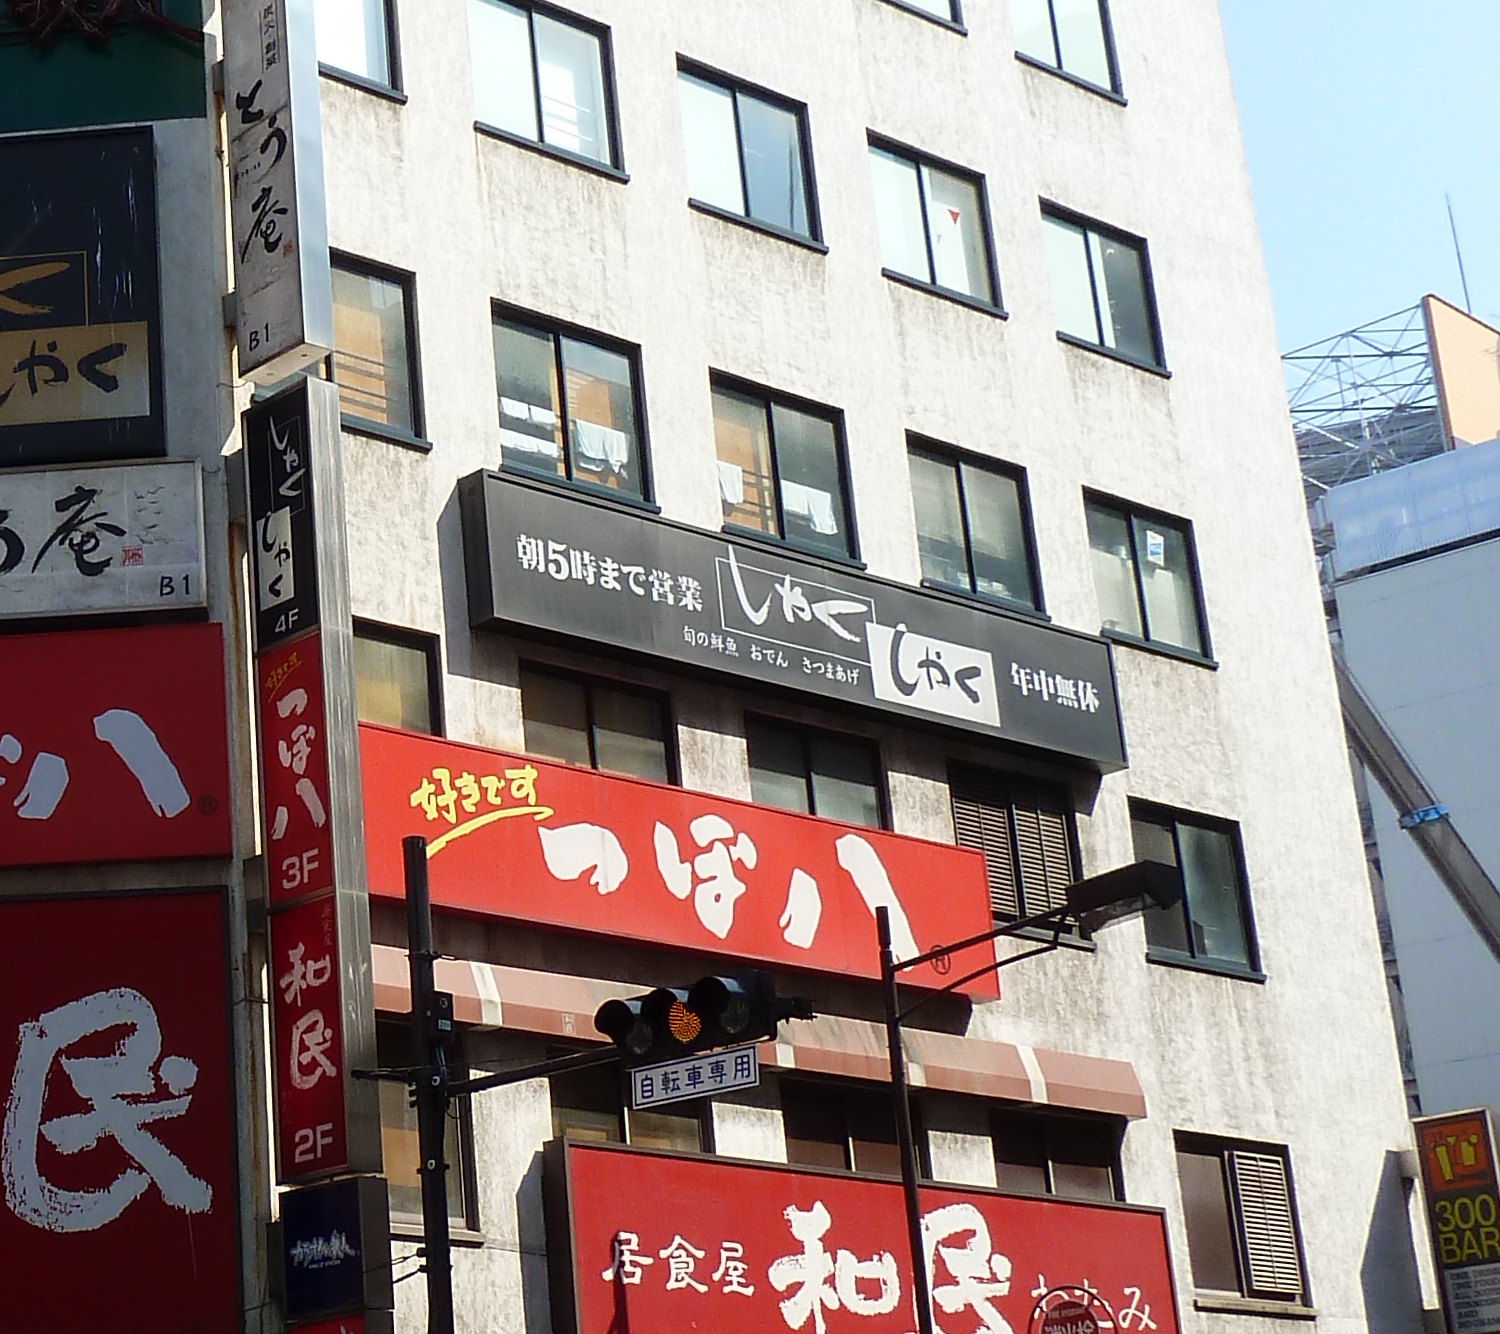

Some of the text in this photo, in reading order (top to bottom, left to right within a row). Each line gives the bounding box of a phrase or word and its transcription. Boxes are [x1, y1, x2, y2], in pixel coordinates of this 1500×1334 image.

[235, 79, 288, 265] とう庵
[248, 322, 270, 353] B1
[270, 416, 305, 497] しゃく
[262, 510, 291, 598] しゃく
[516, 533, 703, 613] 朝5時まで営業
[158, 573, 192, 597] B1
[275, 608, 300, 635] 4F
[728, 544, 982, 706] しゃく しゃく
[683, 626, 860, 686] 旬の鮮魚 おでん さつまあげ
[1010, 662, 1101, 714] 年中無休
[271, 687, 328, 841] つぼ八
[410, 764, 539, 824] 好きです
[282, 848, 320, 890] 3F
[538, 813, 921, 972] つぼ八
[279, 942, 338, 1091] 和民
[640, 1053, 751, 1100] 自転車専用
[294, 1123, 334, 1164] 2F
[1435, 1193, 1497, 1233] 300
[602, 1231, 755, 1297] 居食屋
[1440, 1227, 1500, 1265] BAR
